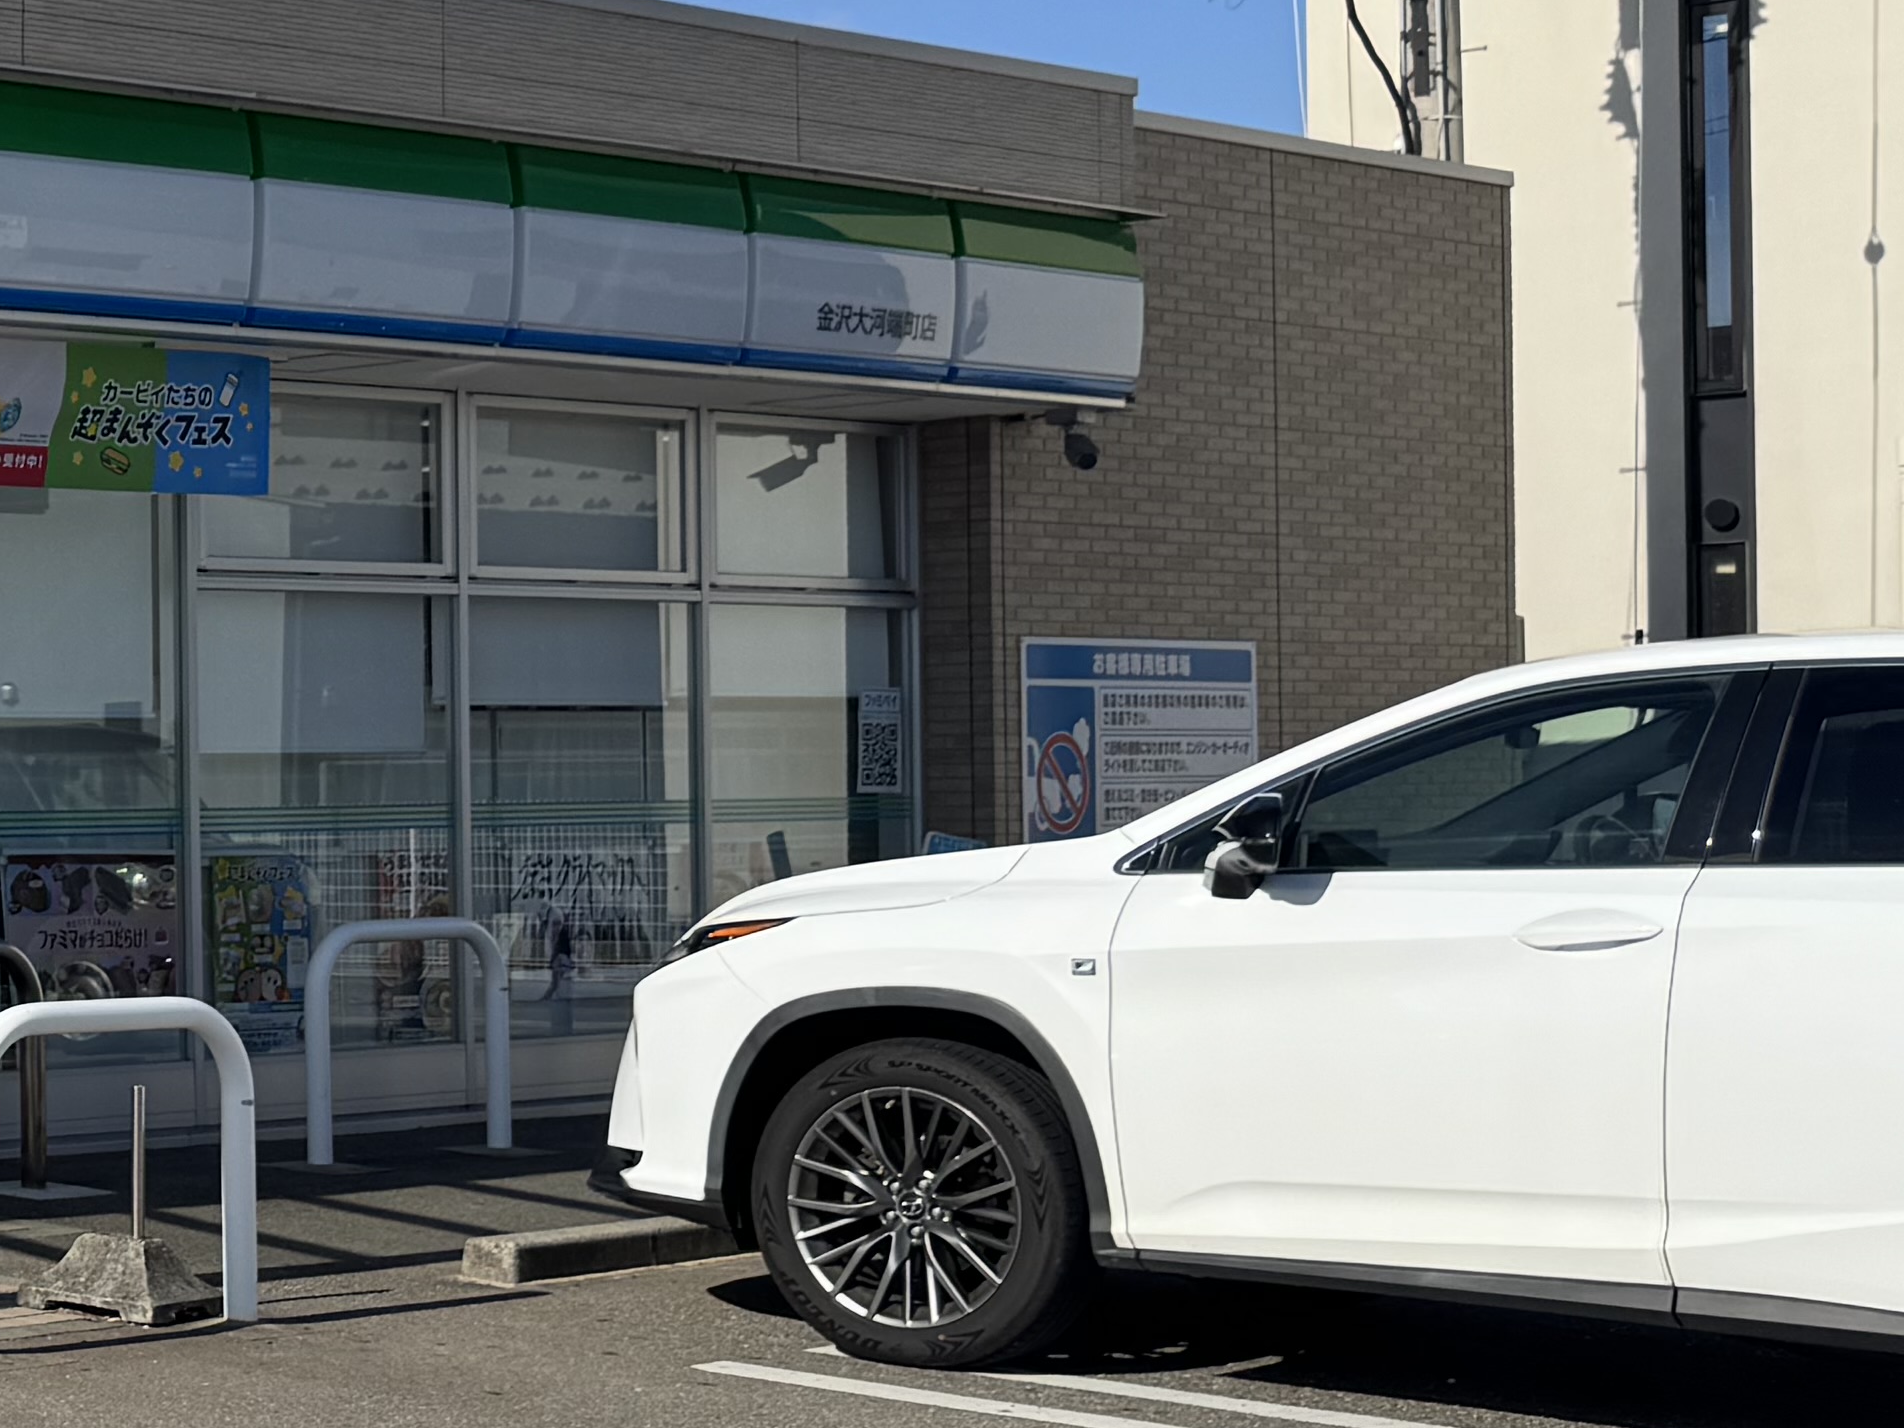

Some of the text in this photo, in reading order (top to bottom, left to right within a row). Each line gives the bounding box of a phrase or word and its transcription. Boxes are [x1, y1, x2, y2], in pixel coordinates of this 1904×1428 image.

[102, 380, 214, 408] カービィたちの
[71, 406, 232, 449] 超まんぞくフェス
